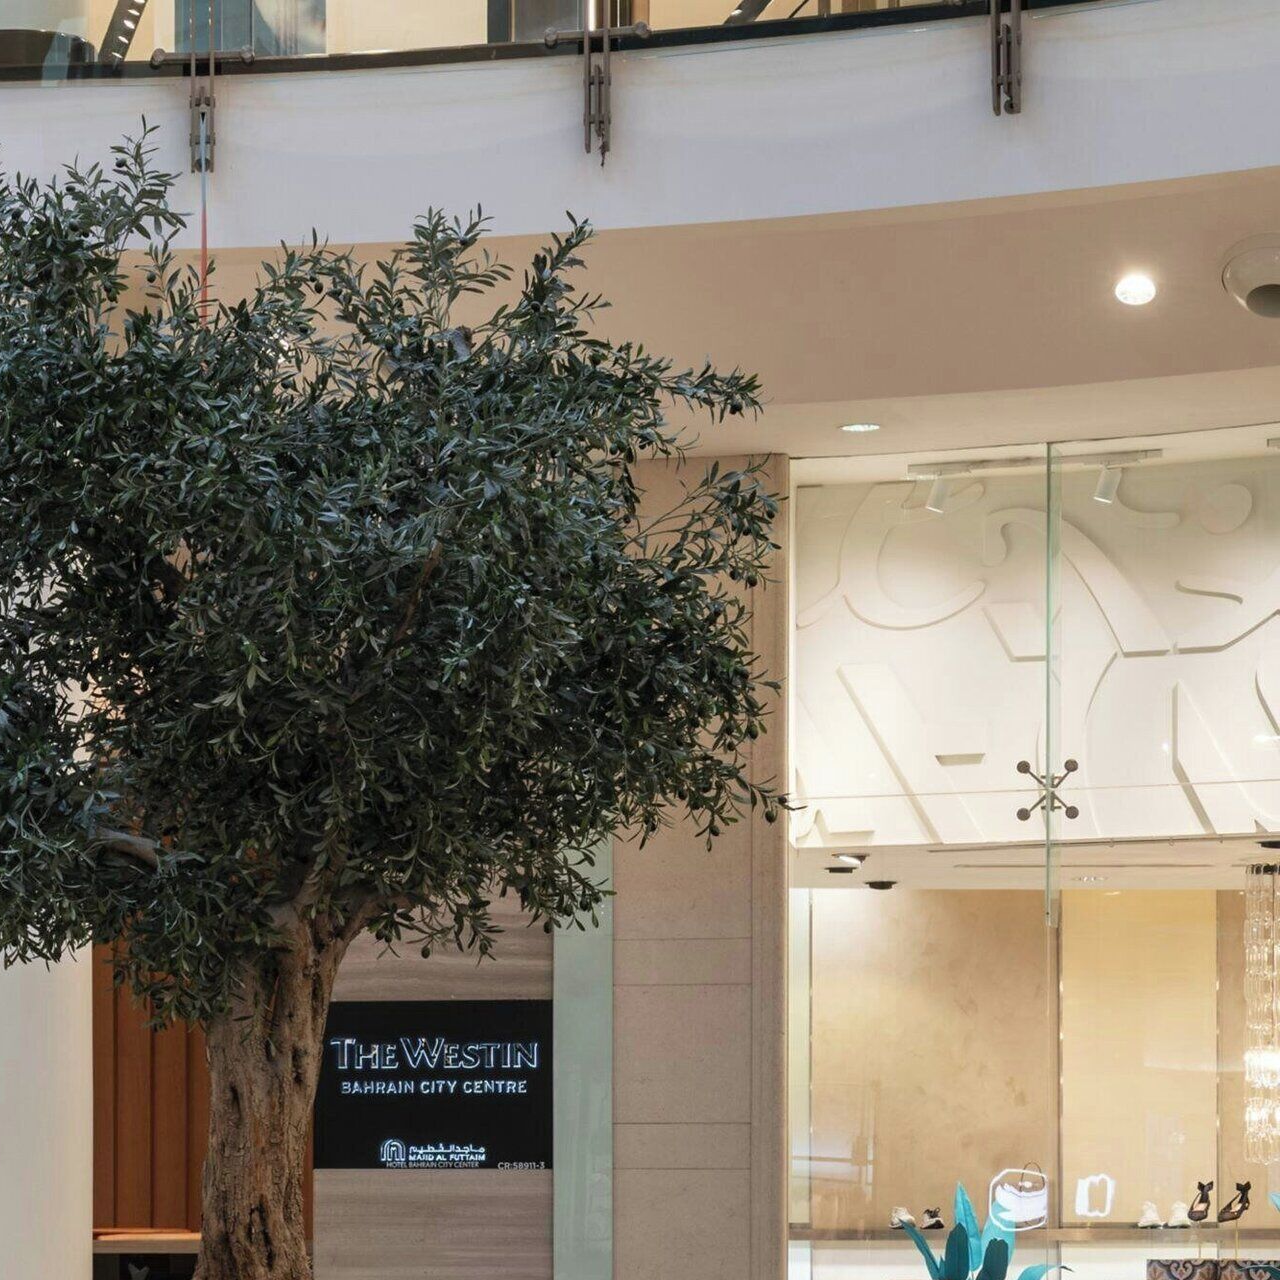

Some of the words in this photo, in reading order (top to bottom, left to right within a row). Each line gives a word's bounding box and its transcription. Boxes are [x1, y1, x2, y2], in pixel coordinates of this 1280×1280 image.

[330, 1038, 399, 1069] THE
[400, 1037, 538, 1069] WESTIN
[341, 1080, 414, 1095] BAHRAIN
[419, 1080, 457, 1094] CITY
[462, 1080, 527, 1094] CENTRE
